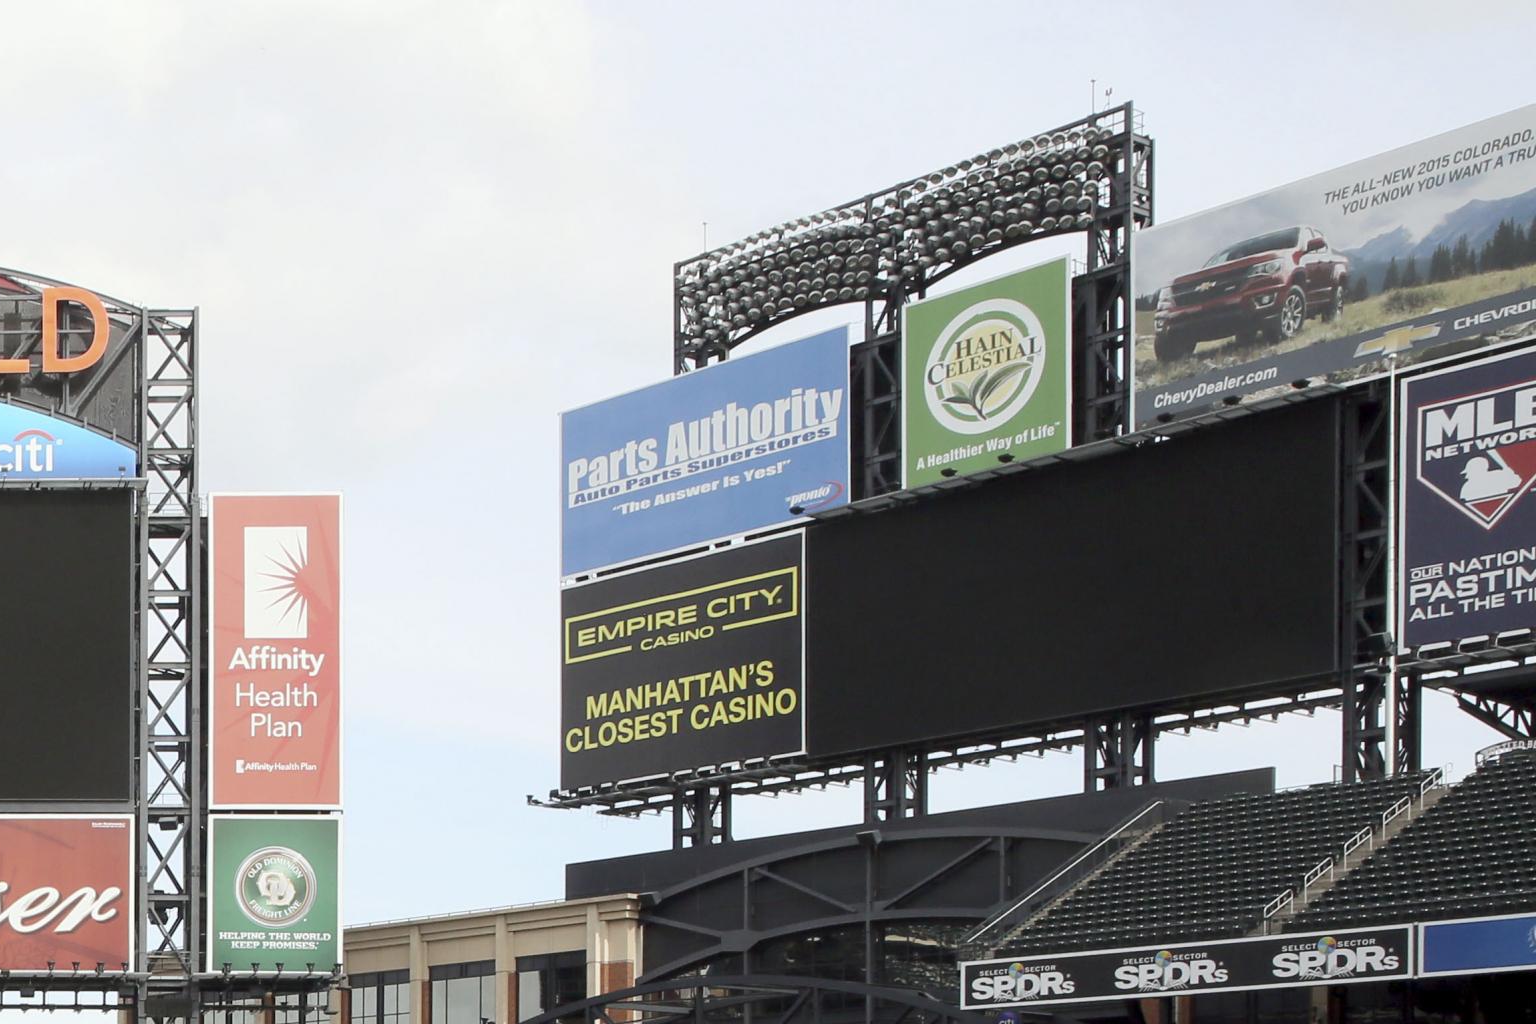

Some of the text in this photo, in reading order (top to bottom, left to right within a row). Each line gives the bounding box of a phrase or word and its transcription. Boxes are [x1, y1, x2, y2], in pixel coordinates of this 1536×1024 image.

[1324, 186, 1352, 205] THE
[1352, 165, 1415, 195] ALL-NEW
[1418, 155, 1450, 175] 2015
[1342, 199, 1368, 215] YOU
[1371, 182, 1415, 207] KNOW
[1417, 176, 1445, 192] YOU
[1449, 158, 1492, 182] WANT
[1493, 156, 1504, 169] A
[955, 328, 1014, 361] HAIN
[1153, 366, 1278, 408] ChevyDealer.com
[568, 387, 844, 494] Parts Authority
[916, 425, 1056, 471] A Healthier Way of Life
[573, 426, 831, 505] Auto Parts Superstores
[654, 479, 720, 505] Answer
[723, 472, 741, 488] Is
[1410, 566, 1443, 580] OUR
[1409, 586, 1536, 623] ALL THE TI
[577, 605, 697, 648] EMPIRE
[640, 625, 714, 651] CASINO
[228, 645, 325, 677] Affinity
[236, 682, 317, 707] Health
[586, 660, 774, 720] MANHATTAN'S
[251, 712, 302, 737] Plan
[565, 688, 797, 753] CLOSEST CASINO
[300, 761, 317, 771] Plan
[247, 861, 263, 879] OLD
[219, 932, 331, 941] HELPING THE WORLD
[231, 941, 260, 949] KEEP
[1281, 938, 1376, 952] SELECT SECTOR
[979, 965, 1056, 977] SELECT SECTOR
[1122, 952, 1208, 966] SELECT SECTOR
